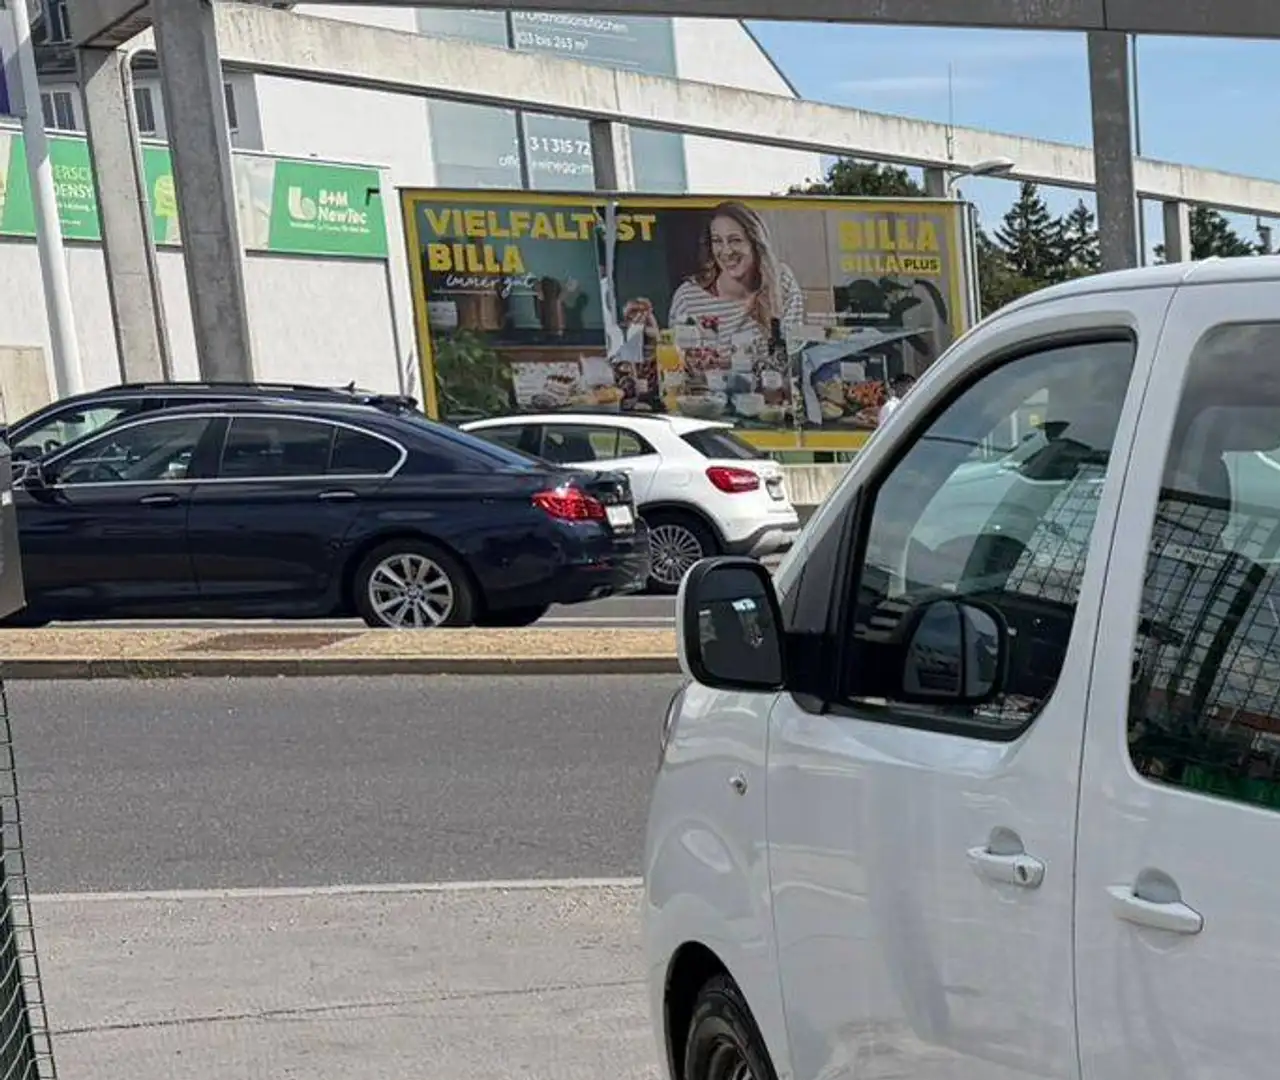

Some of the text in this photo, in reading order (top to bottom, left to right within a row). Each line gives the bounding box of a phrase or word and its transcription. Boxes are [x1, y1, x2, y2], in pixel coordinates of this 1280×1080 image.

[318, 206, 368, 224] NewTec
[424, 208, 656, 241] VIELFALT ST
[838, 219, 939, 251] BILLA
[427, 244, 525, 273] BILLA
[903, 256, 939, 271] PLUS
